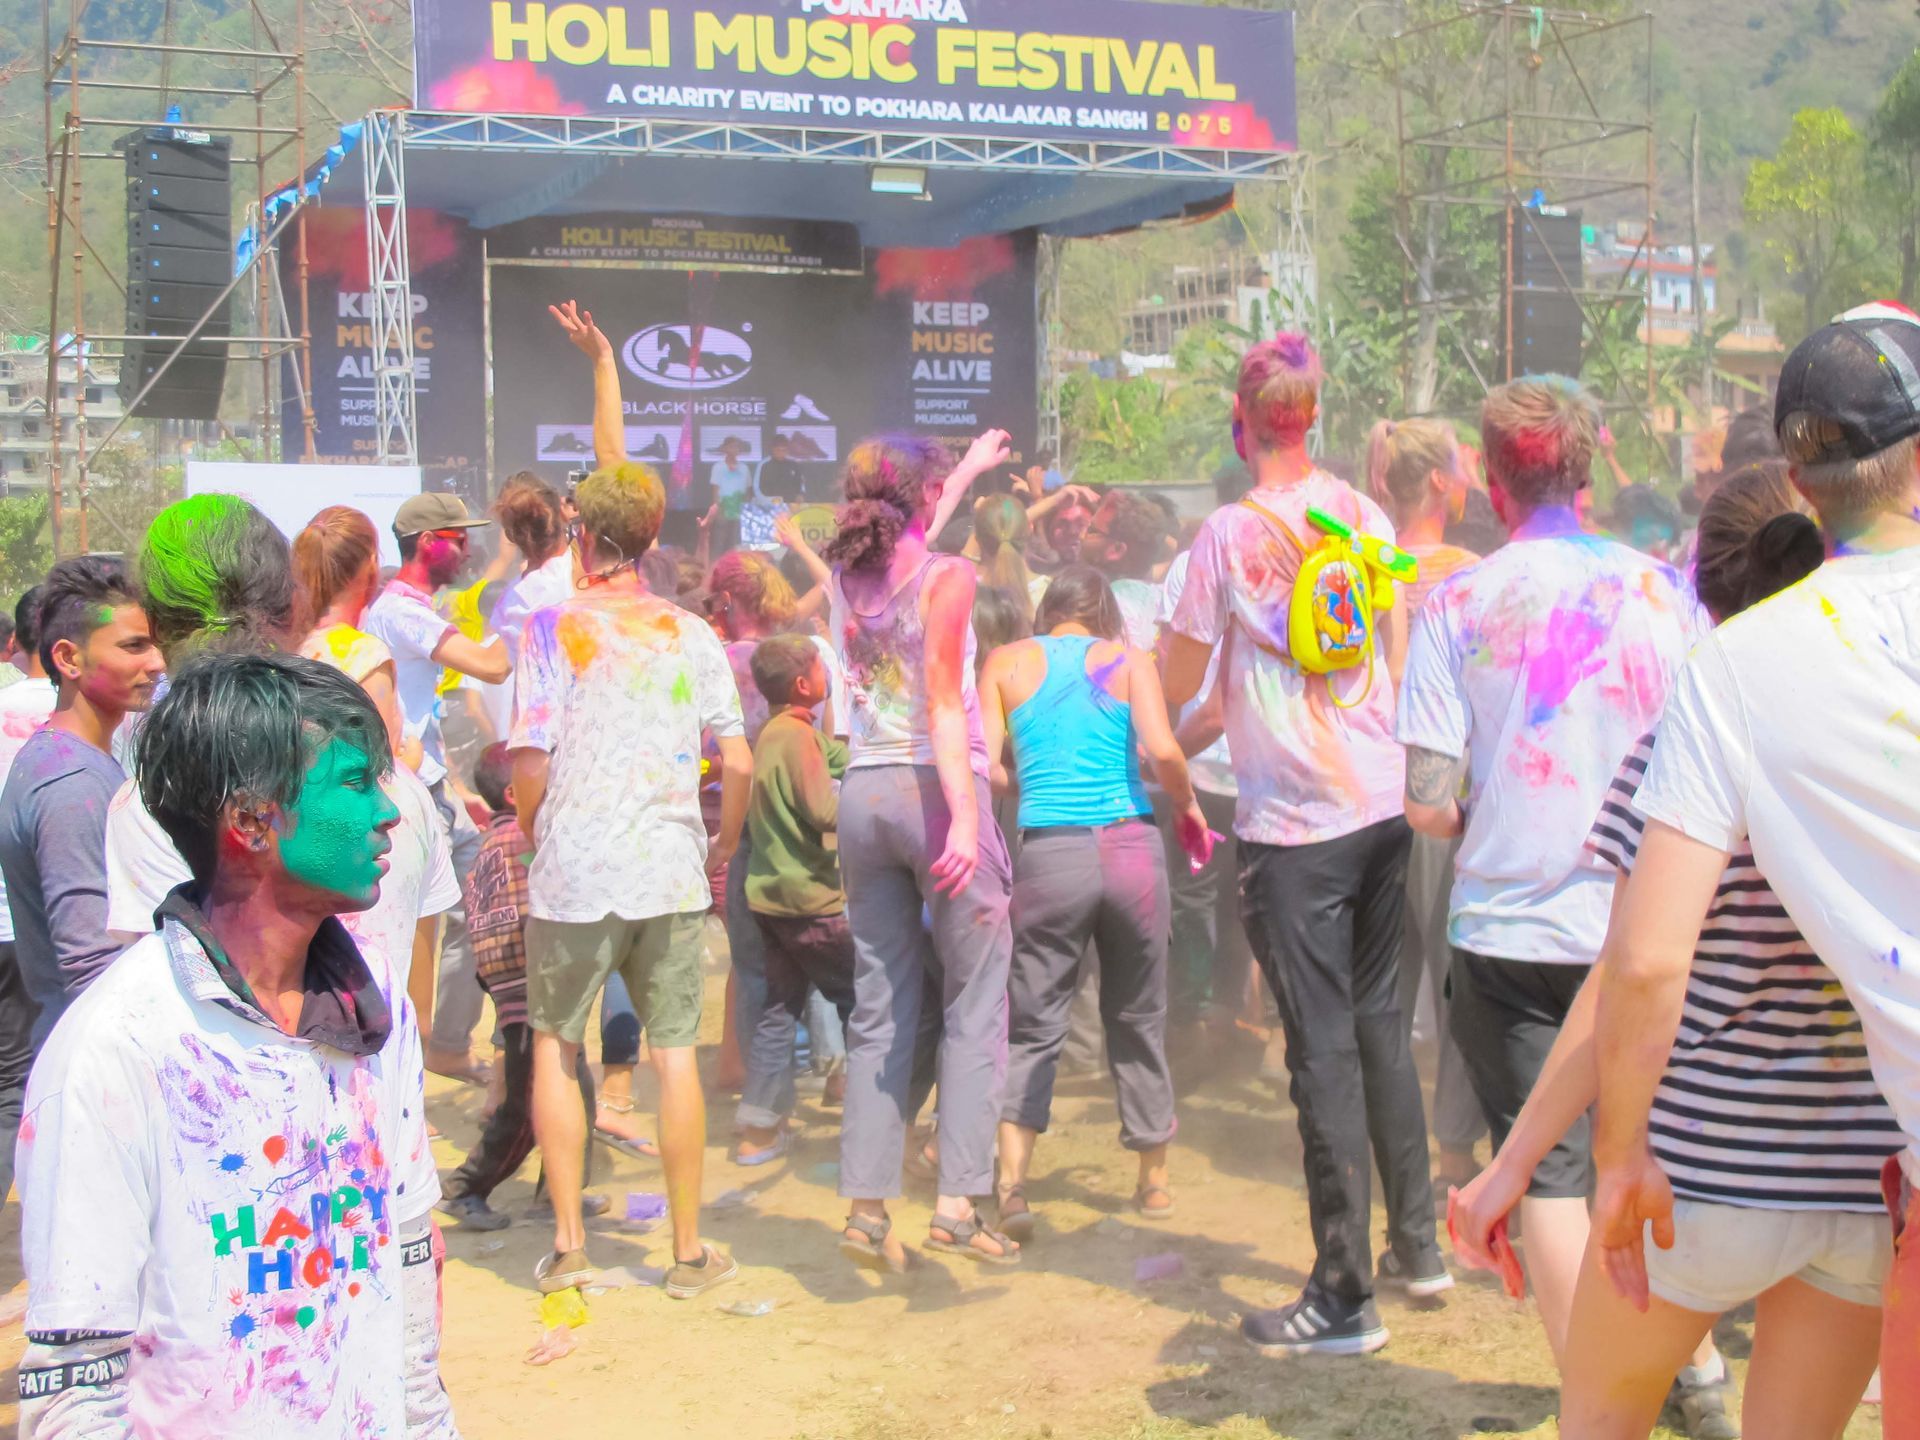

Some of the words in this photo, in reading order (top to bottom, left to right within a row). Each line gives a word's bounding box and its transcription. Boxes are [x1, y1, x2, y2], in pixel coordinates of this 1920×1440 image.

[492, 1, 670, 67] HOLI
[695, 11, 917, 83] MUSIC
[937, 28, 1236, 100] FESTIVAL
[607, 84, 627, 103] A
[632, 85, 735, 108] CHARITY
[740, 90, 814, 113] EVENT
[819, 94, 851, 116] TO
[855, 96, 964, 122] POKHARA
[969, 102, 1072, 126] KALAKAR
[1076, 107, 1148, 131] SANGH
[561, 227, 613, 246] HOLI
[620, 228, 688, 247] MUSIC
[694, 230, 791, 254] FESTIVAL
[530, 247, 540, 256] A
[545, 247, 597, 257] CHARITY
[601, 248, 639, 257] EVENT
[645, 249, 659, 258] TO
[664, 249, 719, 260] POKHARA
[913, 301, 990, 327] KEEP
[337, 325, 434, 350] MUSC
[912, 330, 994, 354] MUSIC
[912, 359, 992, 381] ALIVE
[622, 401, 687, 414] BLACK
[694, 402, 767, 415] HORSE
[915, 399, 969, 410] SUPPORT
[915, 413, 977, 425] MUSICIANS
[210, 1185, 386, 1257] HAPPY
[247, 1235, 368, 1295] HOLI
[18, 1368, 63, 1395] FATE
